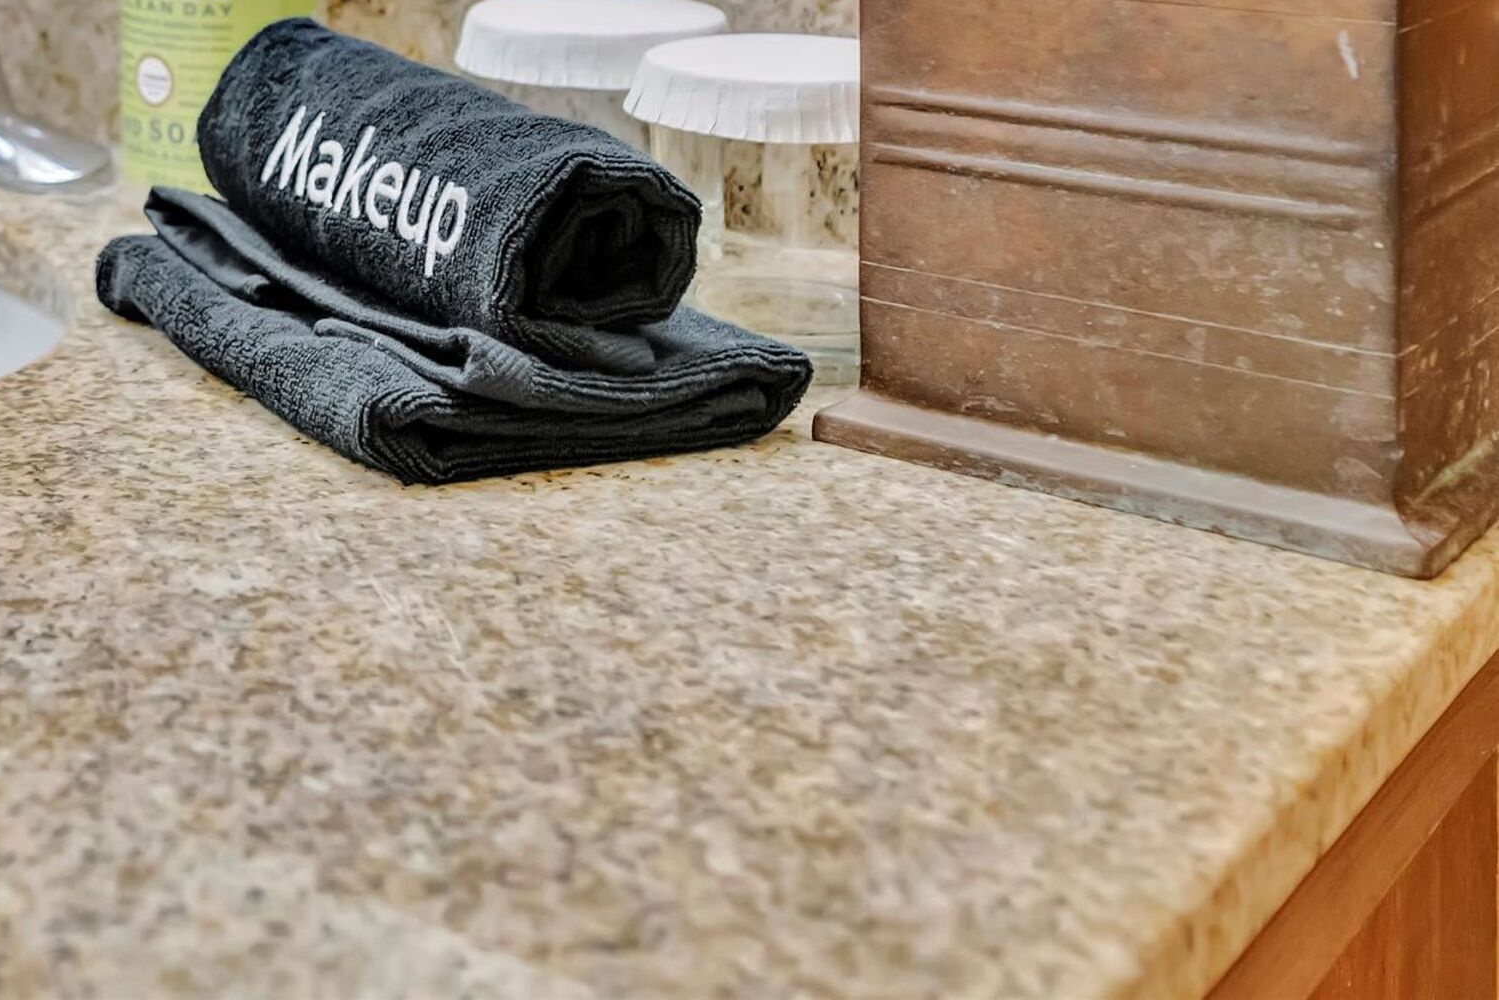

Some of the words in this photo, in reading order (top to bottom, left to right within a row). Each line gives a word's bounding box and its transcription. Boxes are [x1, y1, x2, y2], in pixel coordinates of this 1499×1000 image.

[183, 2, 233, 17] DAY
[149, 117, 200, 145] SO
[260, 105, 469, 279] Makeup
